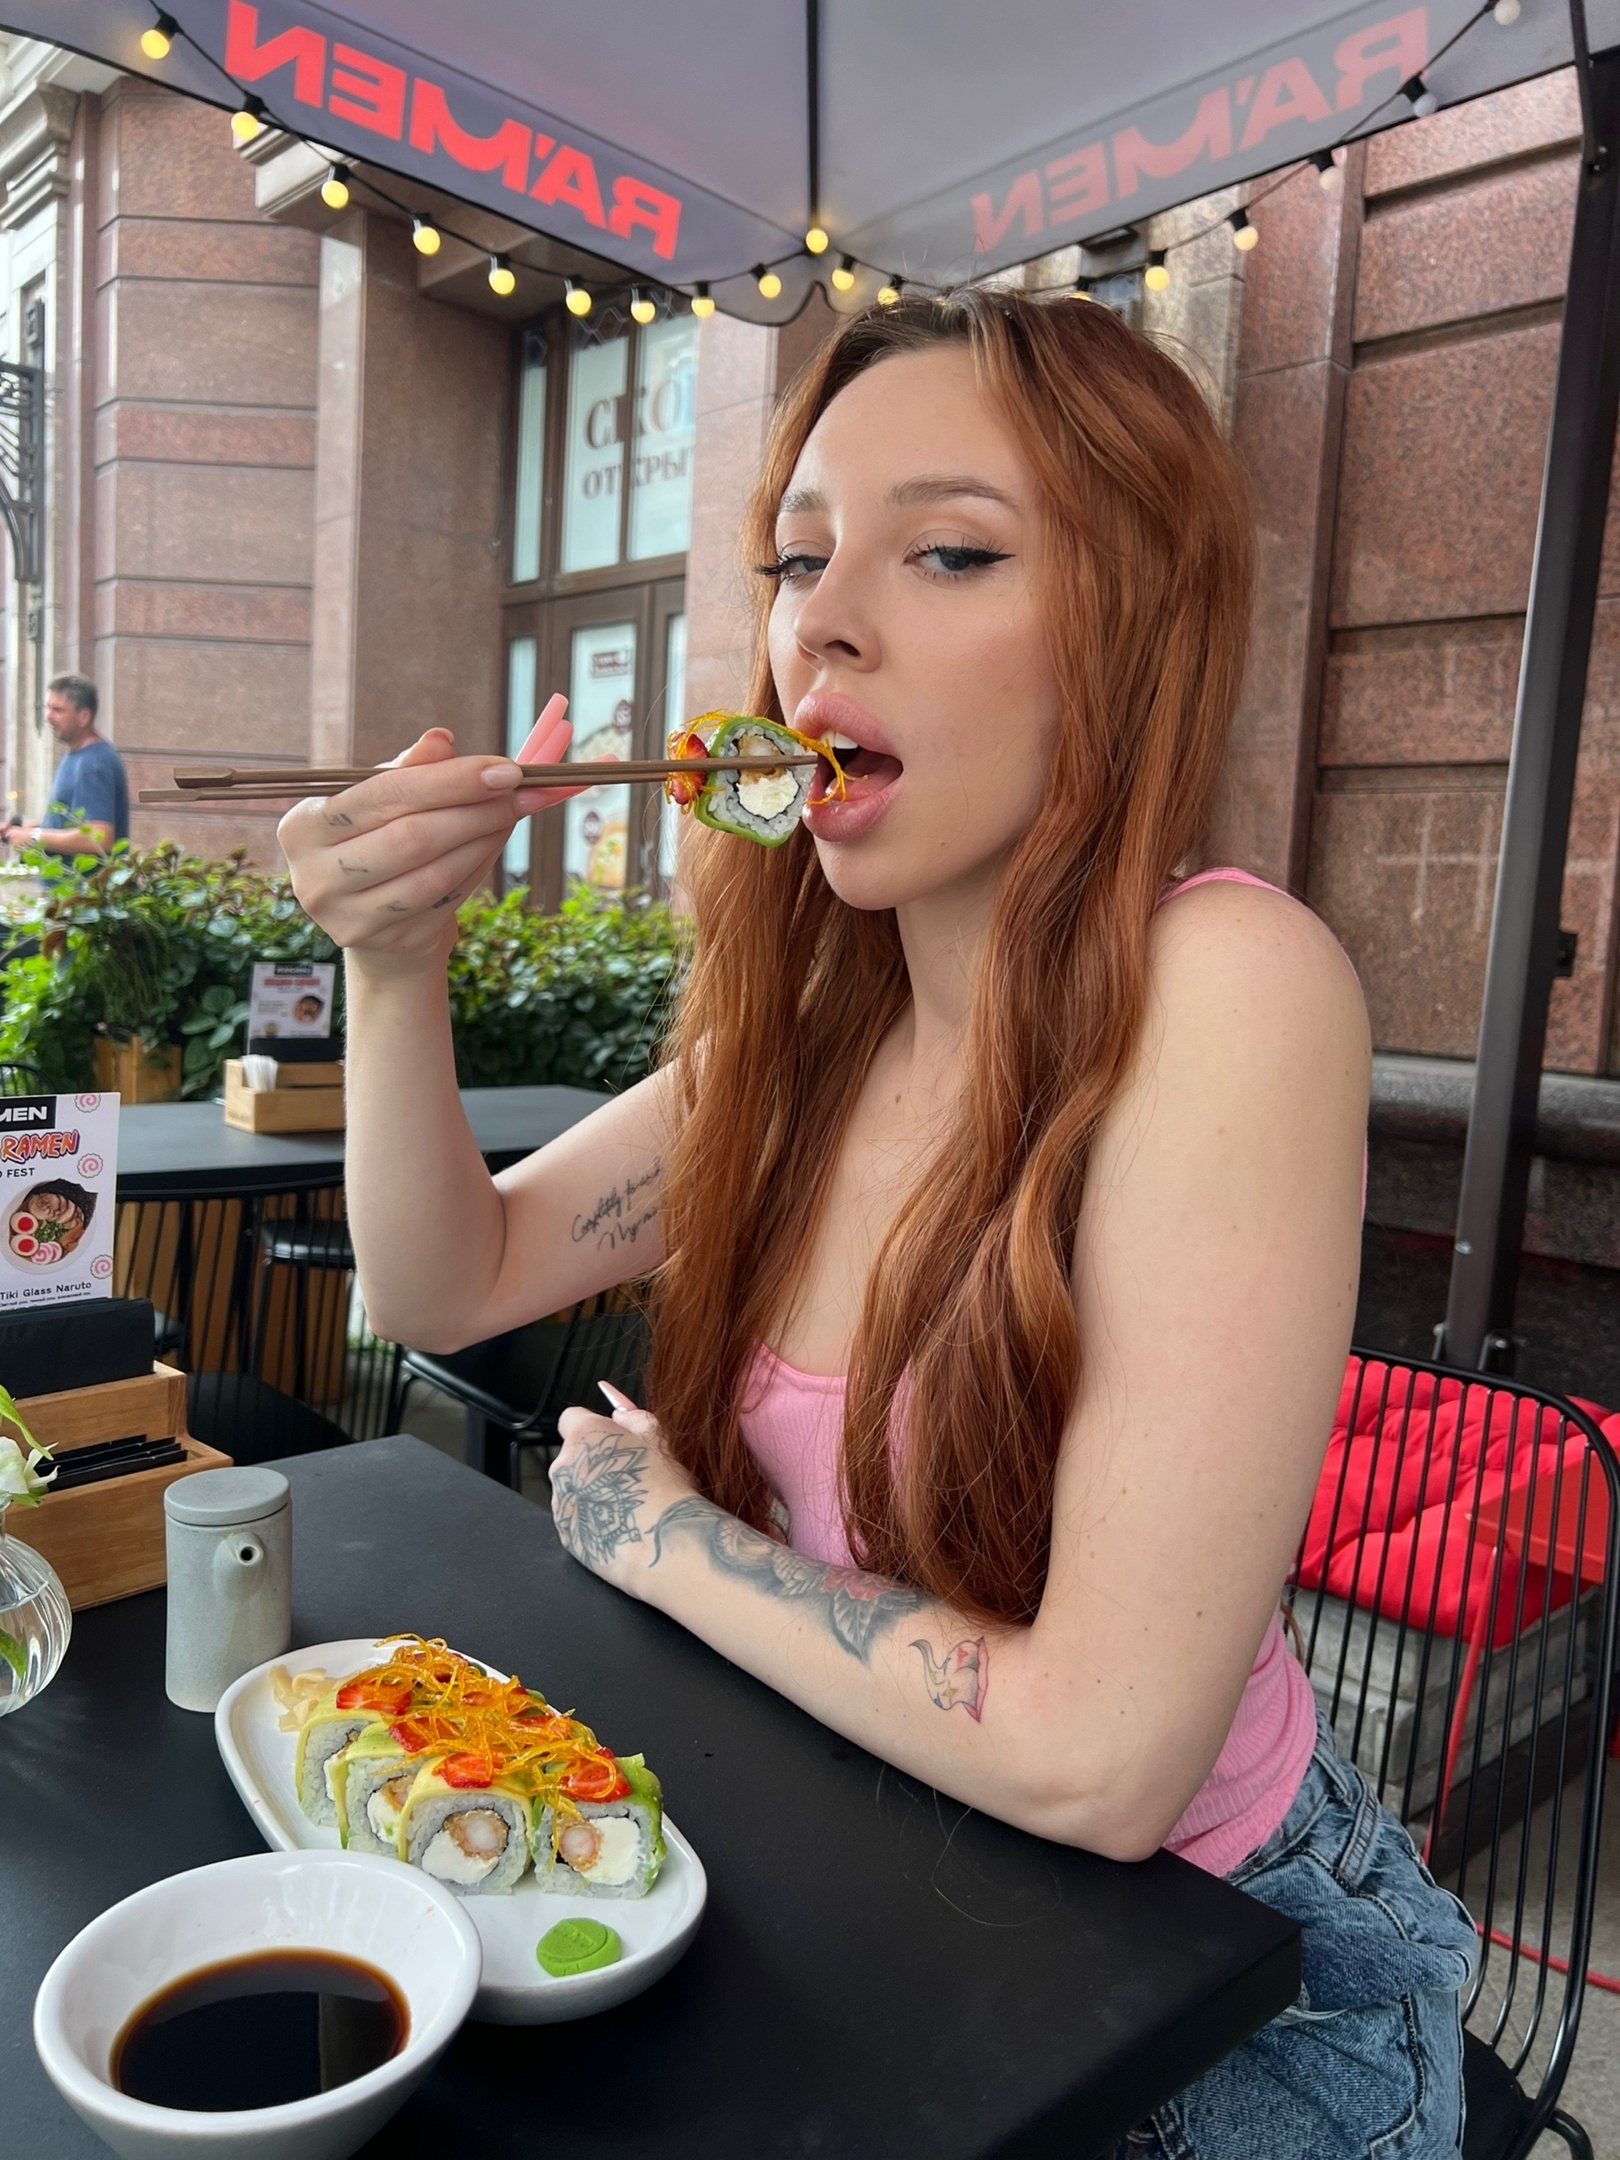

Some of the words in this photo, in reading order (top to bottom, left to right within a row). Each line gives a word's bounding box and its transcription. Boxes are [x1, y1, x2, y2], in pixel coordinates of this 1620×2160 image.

[1, 1129, 80, 1164] RAMEN
[7, 1167, 35, 1178] FEST
[0, 1290, 19, 1300] Tiki
[23, 1287, 52, 1297] Glass
[56, 1281, 92, 1293] Naruto
